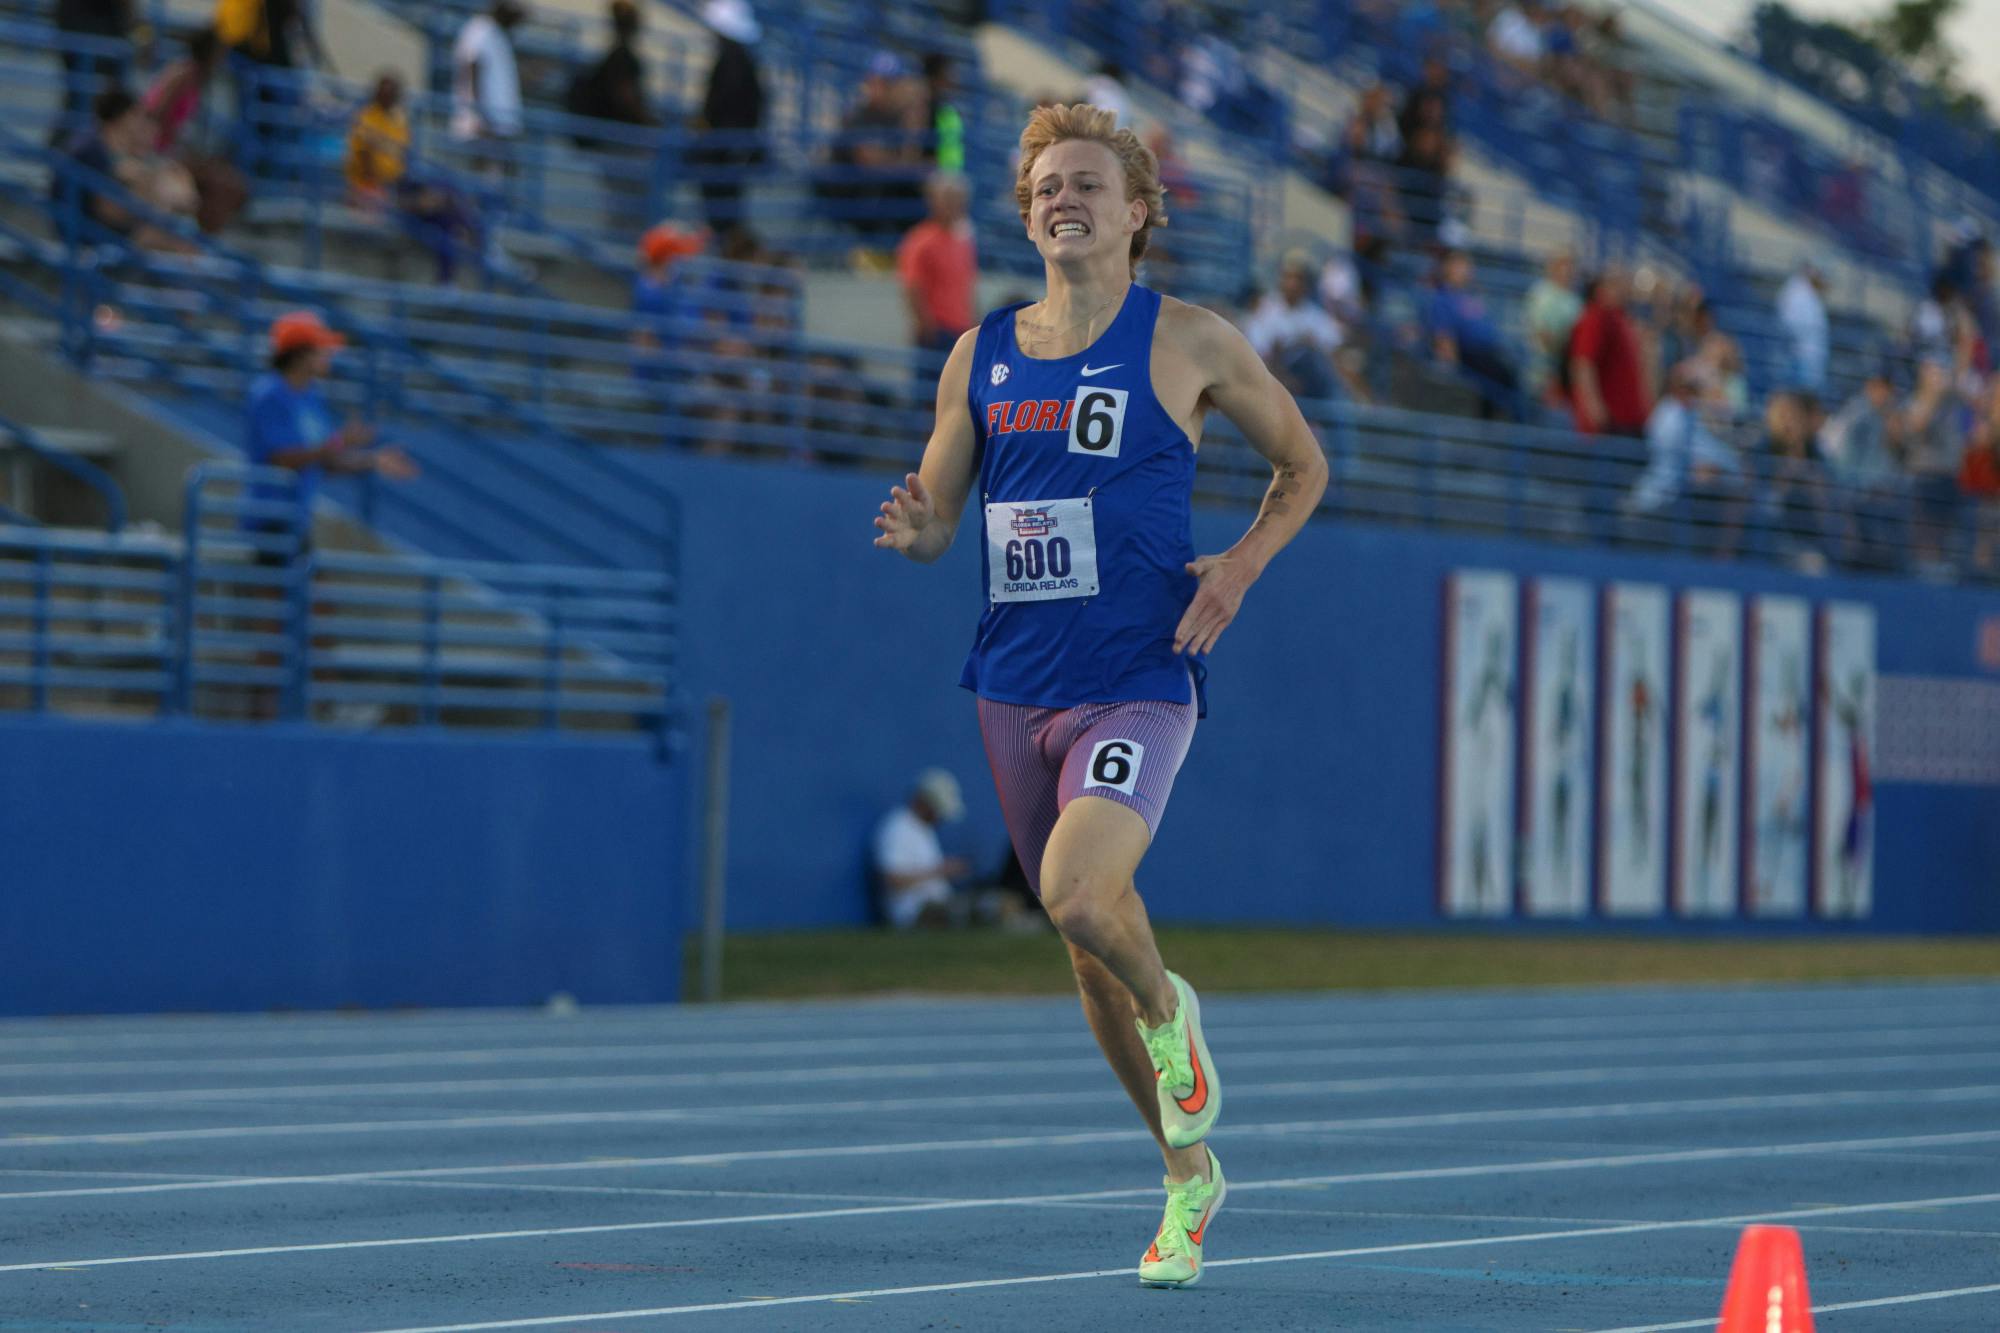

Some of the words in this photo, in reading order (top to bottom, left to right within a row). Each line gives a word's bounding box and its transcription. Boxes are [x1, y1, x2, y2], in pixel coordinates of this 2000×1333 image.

[991, 363, 1010, 386] SEC
[987, 400, 1075, 438] FLORI
[1076, 391, 1117, 451] 6
[1006, 537, 1071, 581] 600
[1004, 582, 1038, 592] FLORIDA
[1040, 578, 1078, 590] RELAYS
[1092, 742, 1133, 785] 6
